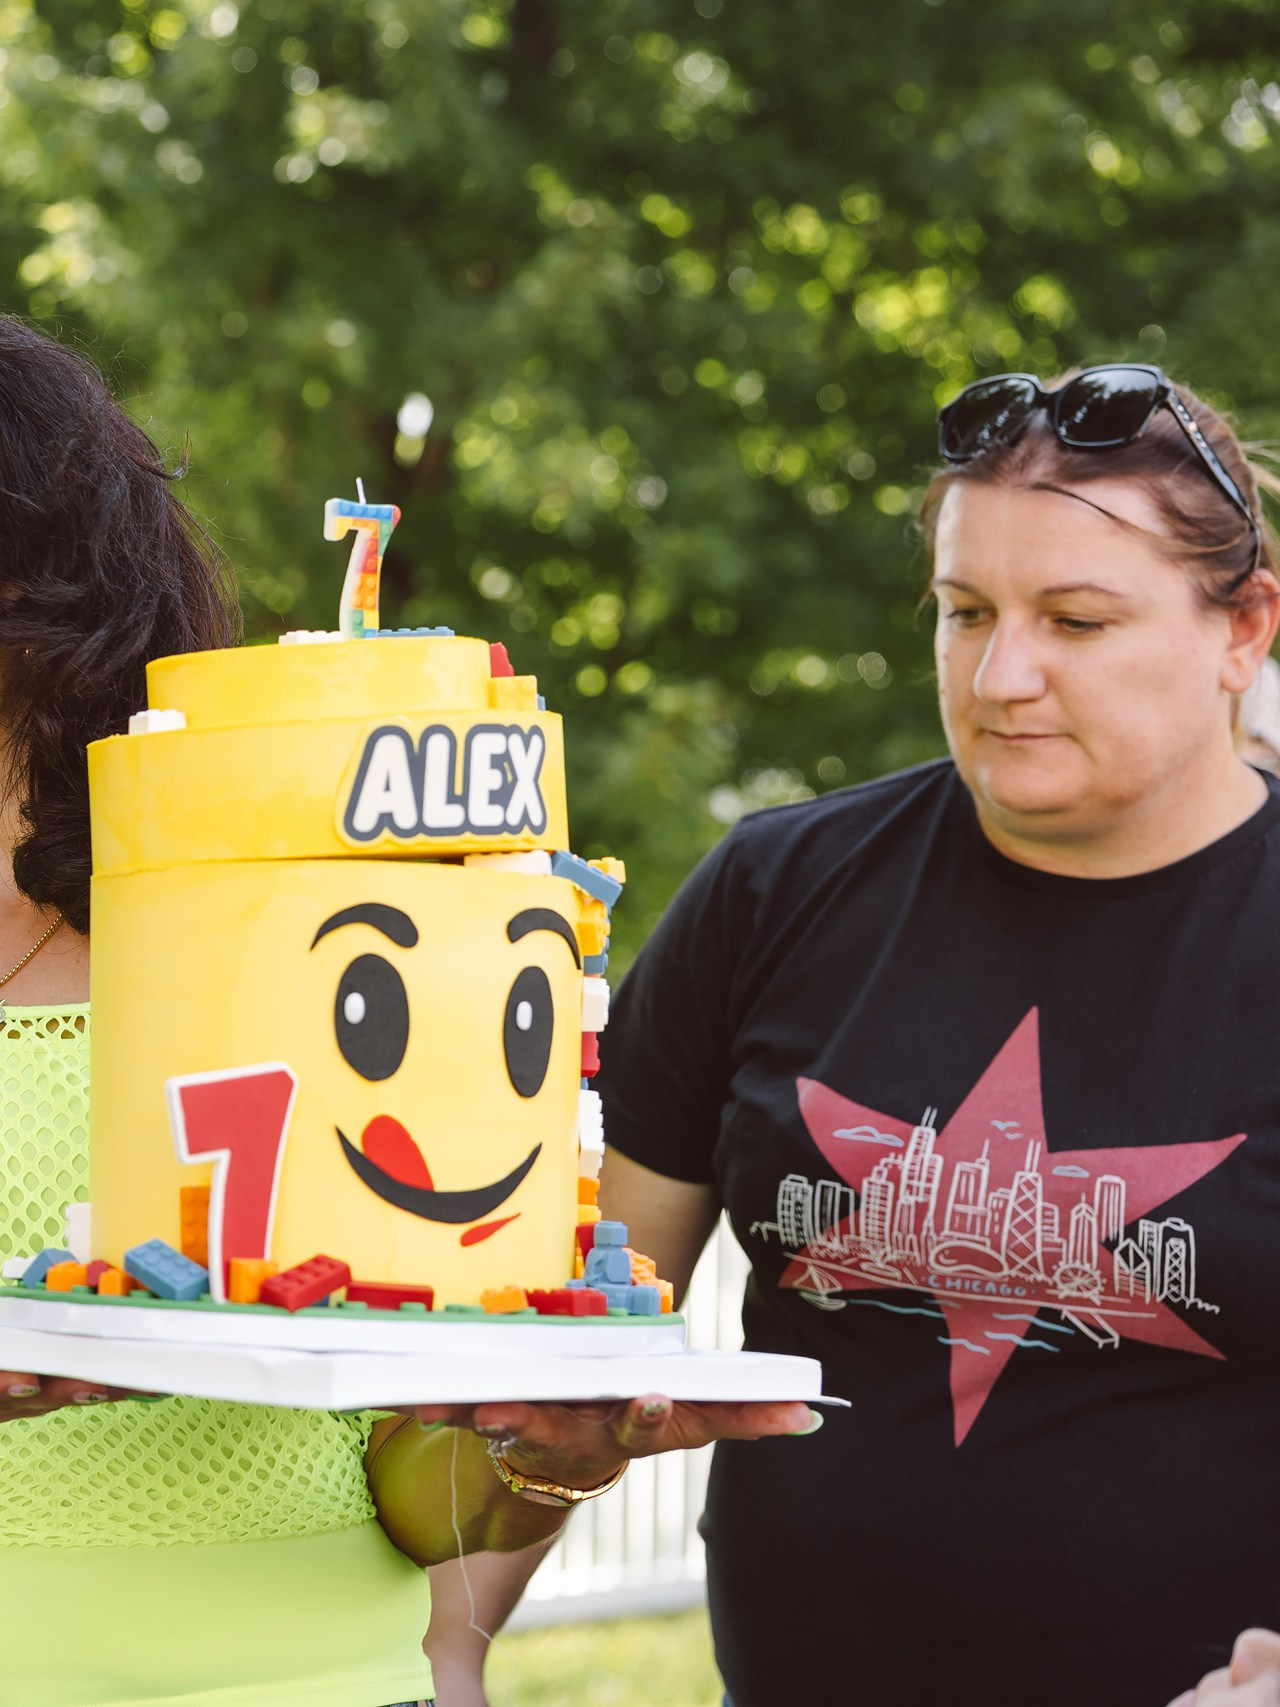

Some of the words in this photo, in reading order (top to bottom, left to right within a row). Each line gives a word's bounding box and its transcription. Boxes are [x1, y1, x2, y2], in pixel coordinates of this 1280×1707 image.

[324, 498, 401, 639] 7
[345, 724, 547, 841] ALEX
[165, 1061, 298, 1304] 7
[927, 1274, 1027, 1297] CHICAGO
